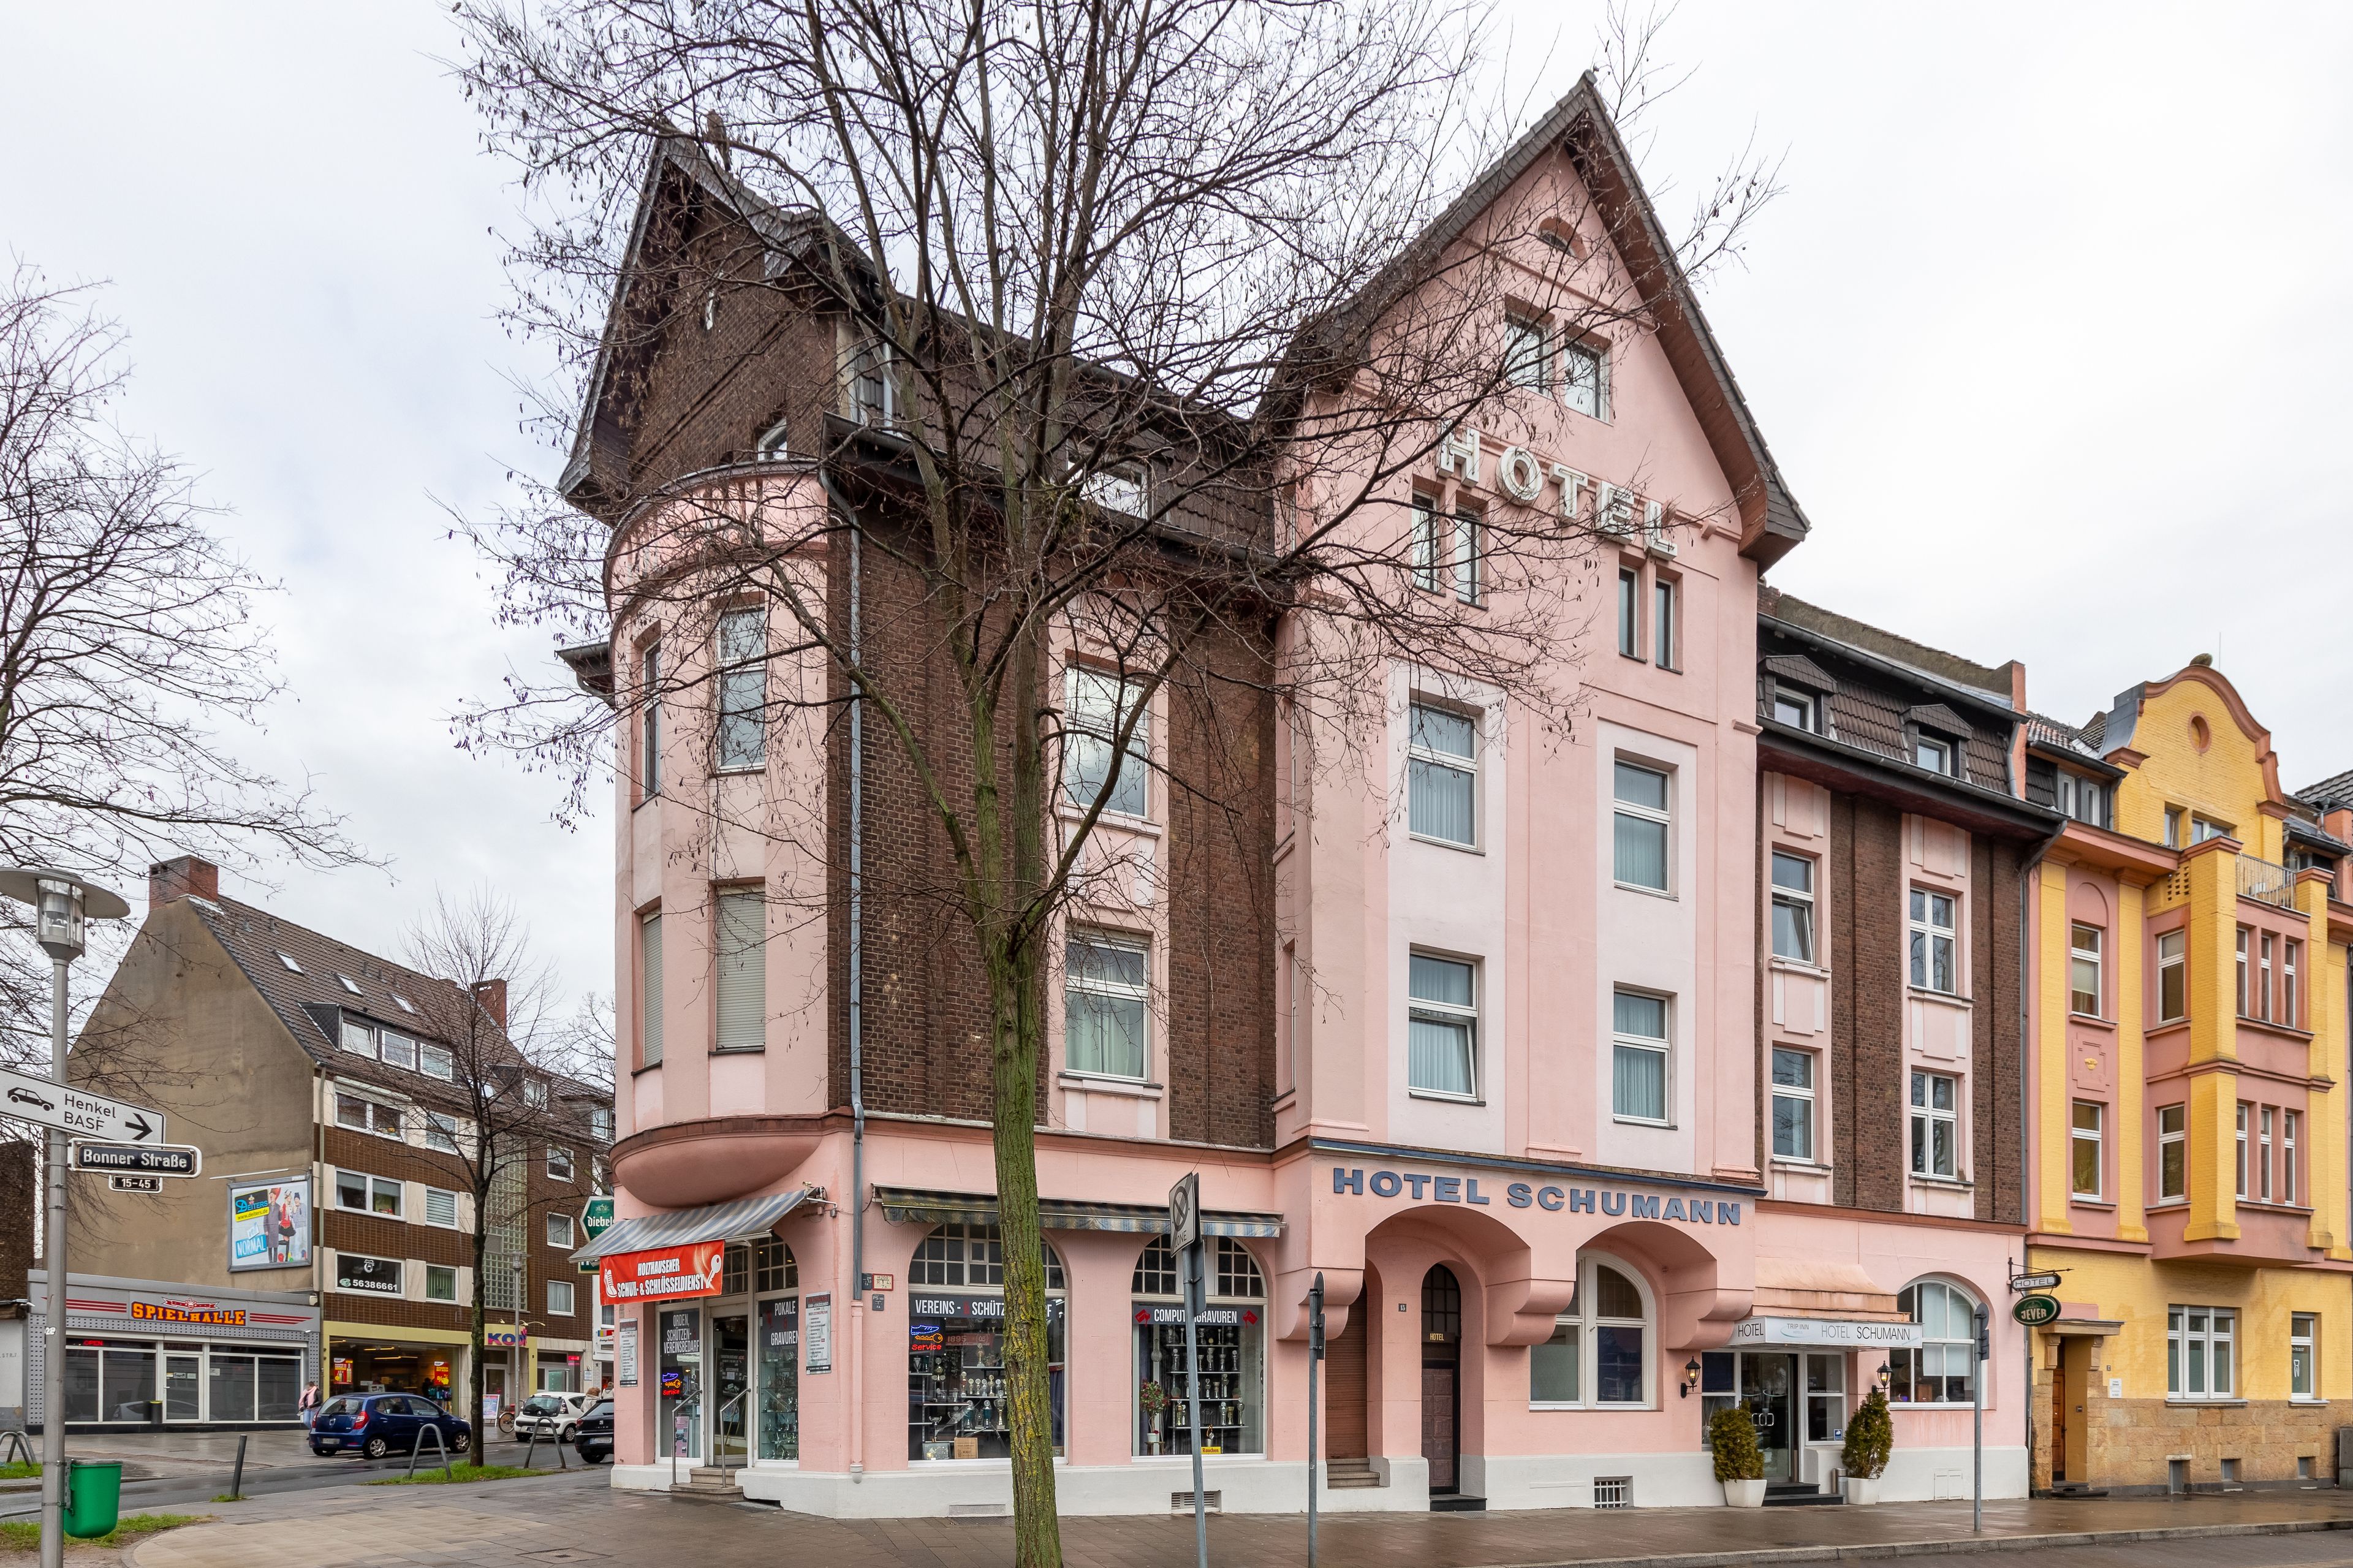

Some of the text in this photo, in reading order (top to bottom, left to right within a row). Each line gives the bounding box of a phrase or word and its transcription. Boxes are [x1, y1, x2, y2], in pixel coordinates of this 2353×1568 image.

[1438, 421, 1677, 561] HOTEL
[64, 1093, 116, 1118] Henkel
[64, 1111, 105, 1131] BASF
[83, 1149, 187, 1168] Bonner Straße
[121, 1178, 151, 1189] 15-45
[1333, 1167, 1741, 1225] HOTEL SCHUMANN
[237, 1235, 266, 1257] NORMAL
[637, 1258, 680, 1277] HOLTHAUSENER
[352, 1279, 398, 1291] 56386661
[616, 1273, 705, 1298] SCHUH- & SCHLÜSSELDIENST
[2015, 1278, 2053, 1287] HOTEL
[132, 1301, 246, 1326] SPIELHALLE
[775, 1300, 796, 1316] POKALE
[915, 1299, 955, 1314] VEREINS
[2020, 1308, 2047, 1320] JEVER
[673, 1313, 690, 1327] ORDEN,
[667, 1327, 692, 1342] SCHÜTZEN-
[1738, 1324, 1764, 1337] HOTEL
[1822, 1324, 1910, 1341] HOTEL SCHUMANN
[664, 1339, 700, 1354] VEREINSBEDARF
